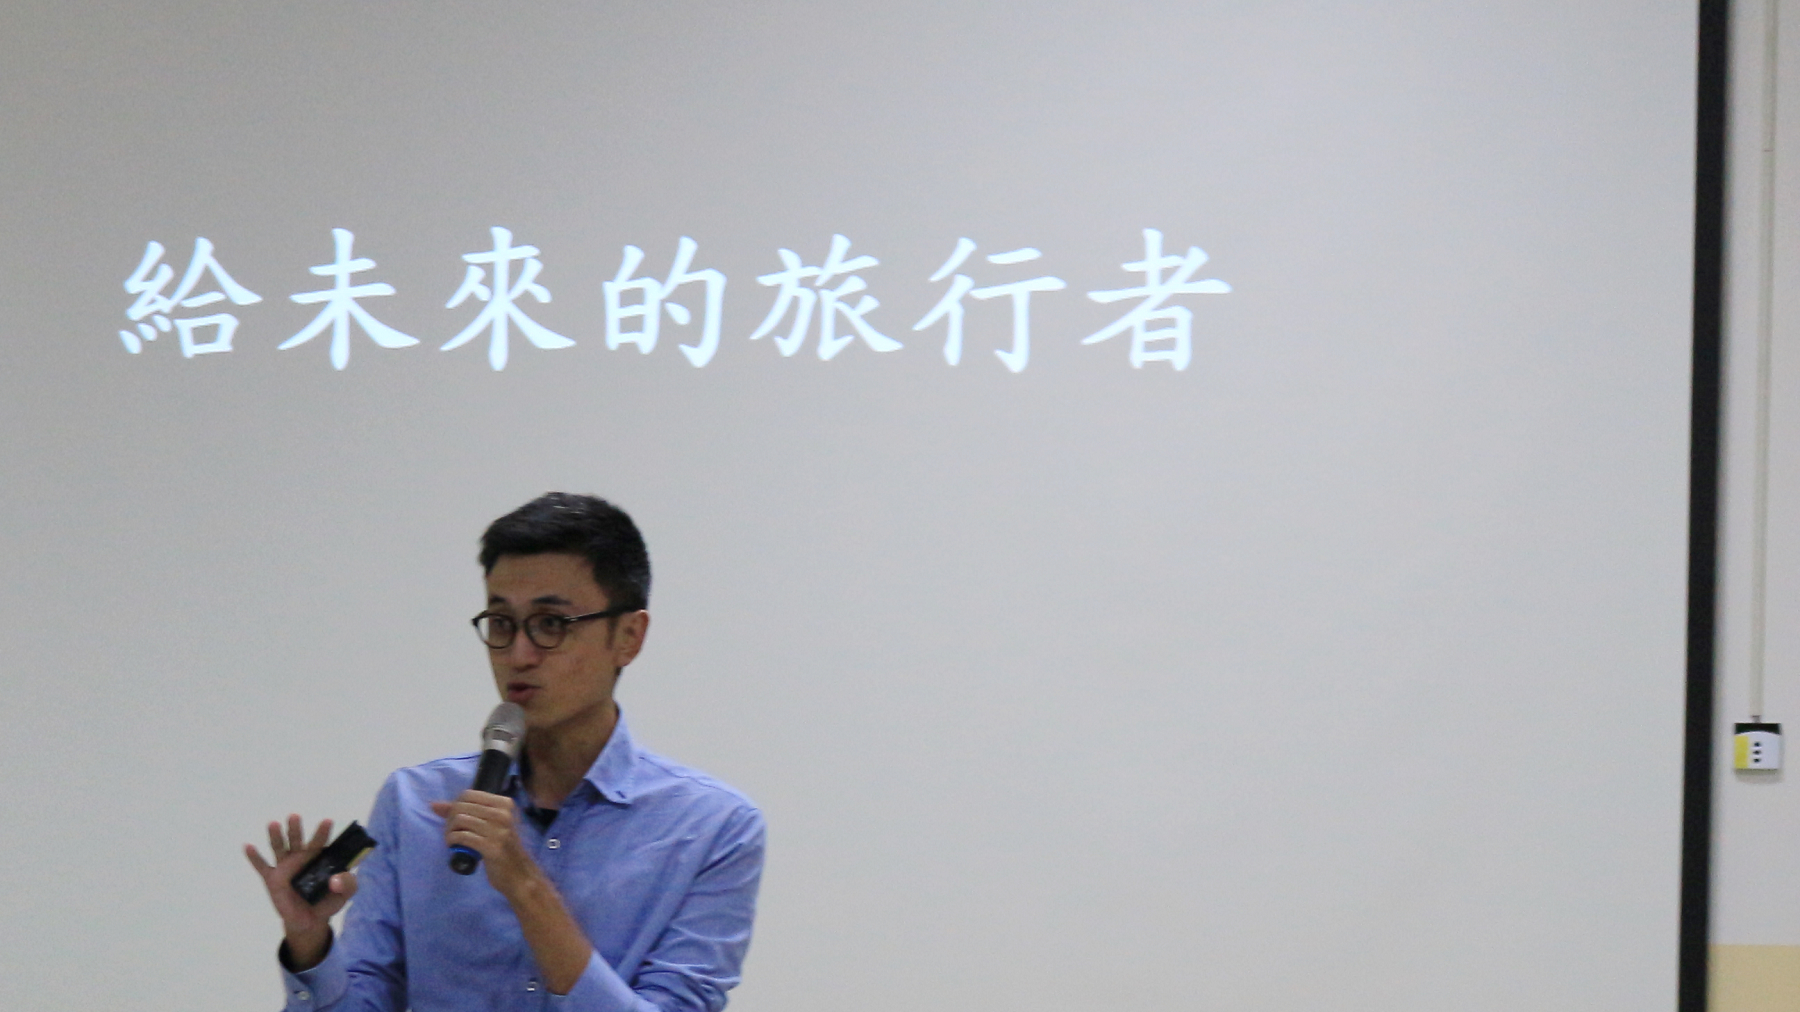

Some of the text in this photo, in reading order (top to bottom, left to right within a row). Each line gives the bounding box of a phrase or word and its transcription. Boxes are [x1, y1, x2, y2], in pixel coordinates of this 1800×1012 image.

[118, 226, 1233, 374] 給未來的旅行者
